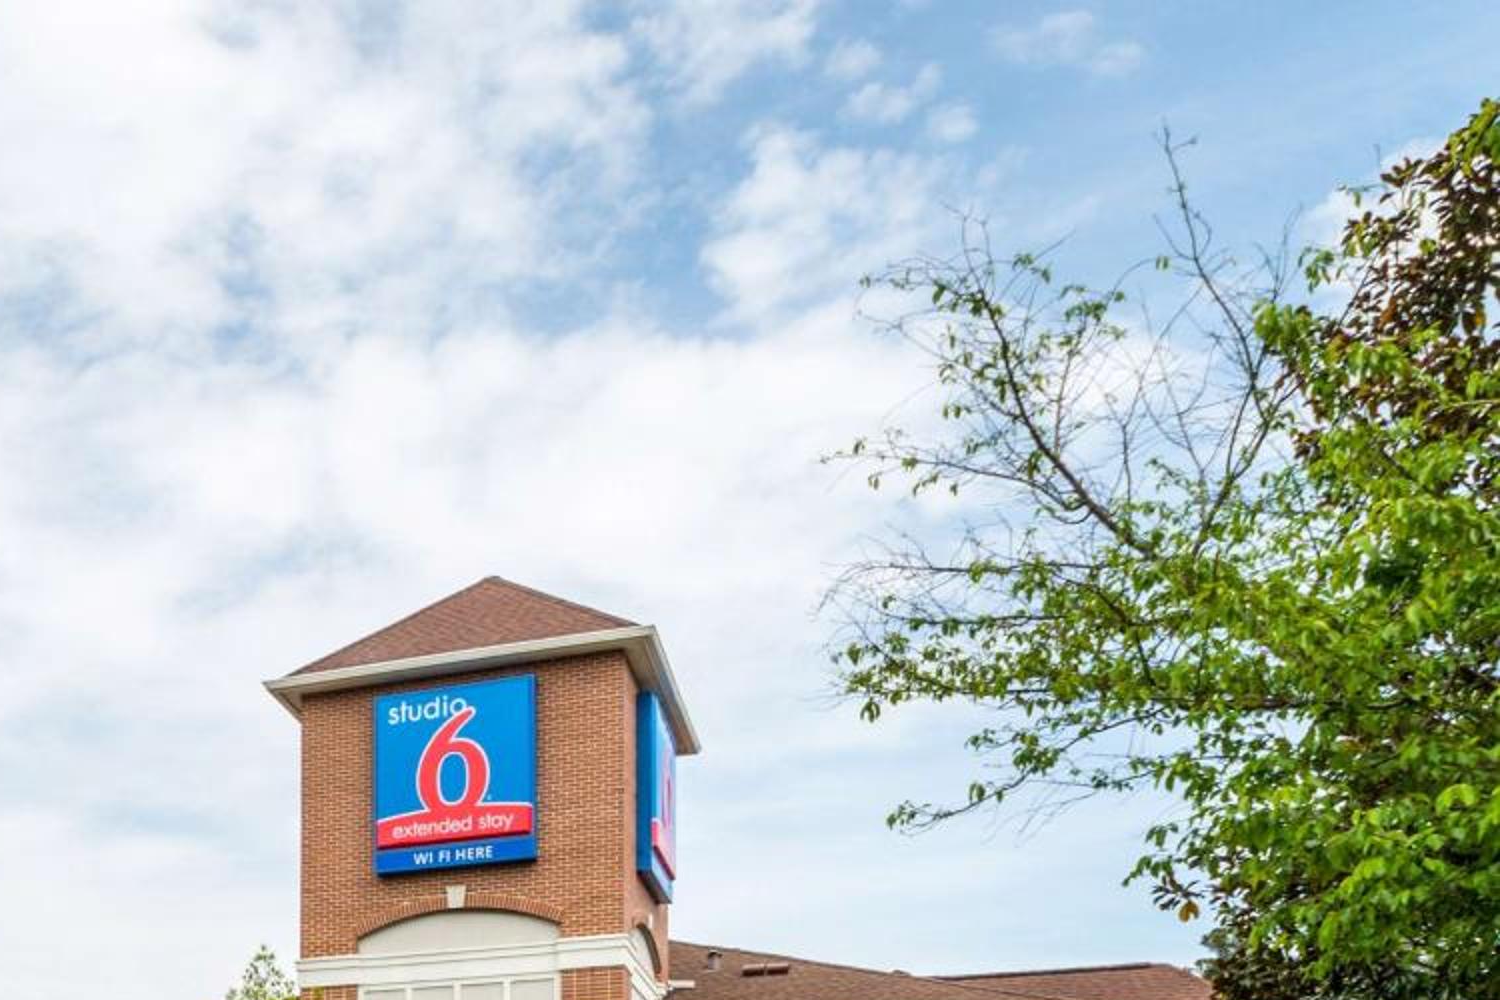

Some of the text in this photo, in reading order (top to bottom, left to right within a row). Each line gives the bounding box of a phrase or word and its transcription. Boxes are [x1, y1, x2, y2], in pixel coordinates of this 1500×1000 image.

[388, 695, 467, 725] studio
[415, 705, 490, 811] 6
[392, 813, 514, 840] extended stay
[413, 845, 493, 865] WI FI HERE
